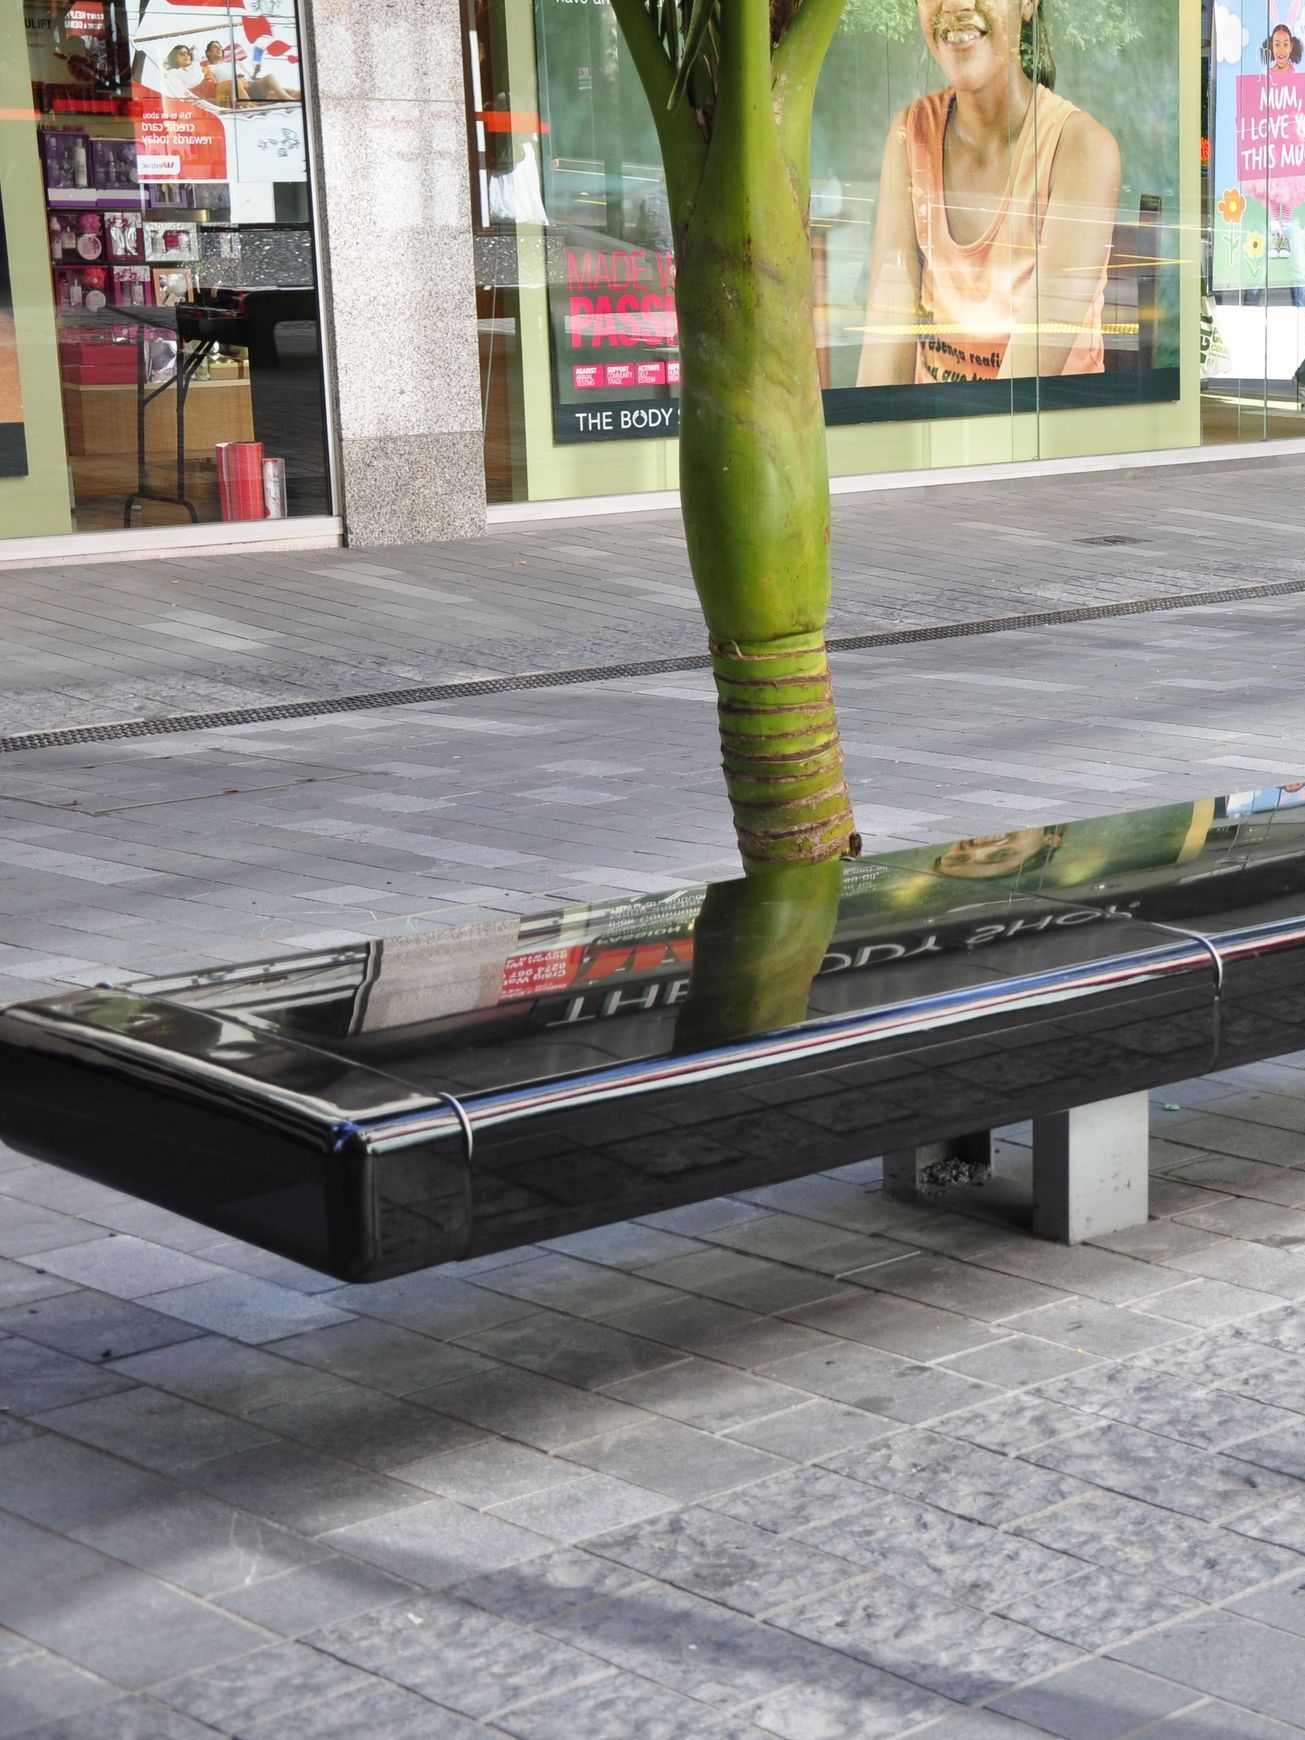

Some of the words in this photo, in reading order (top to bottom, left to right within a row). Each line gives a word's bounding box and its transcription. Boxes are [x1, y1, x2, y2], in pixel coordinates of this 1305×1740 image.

[1260, 85, 1302, 111] MUM,
[1240, 117, 1245, 141] I
[1251, 114, 1290, 141] LOVE
[1241, 145, 1277, 171] THIS
[567, 250, 649, 293] MADE
[575, 411, 613, 431] THE
[621, 407, 673, 429] BODY
